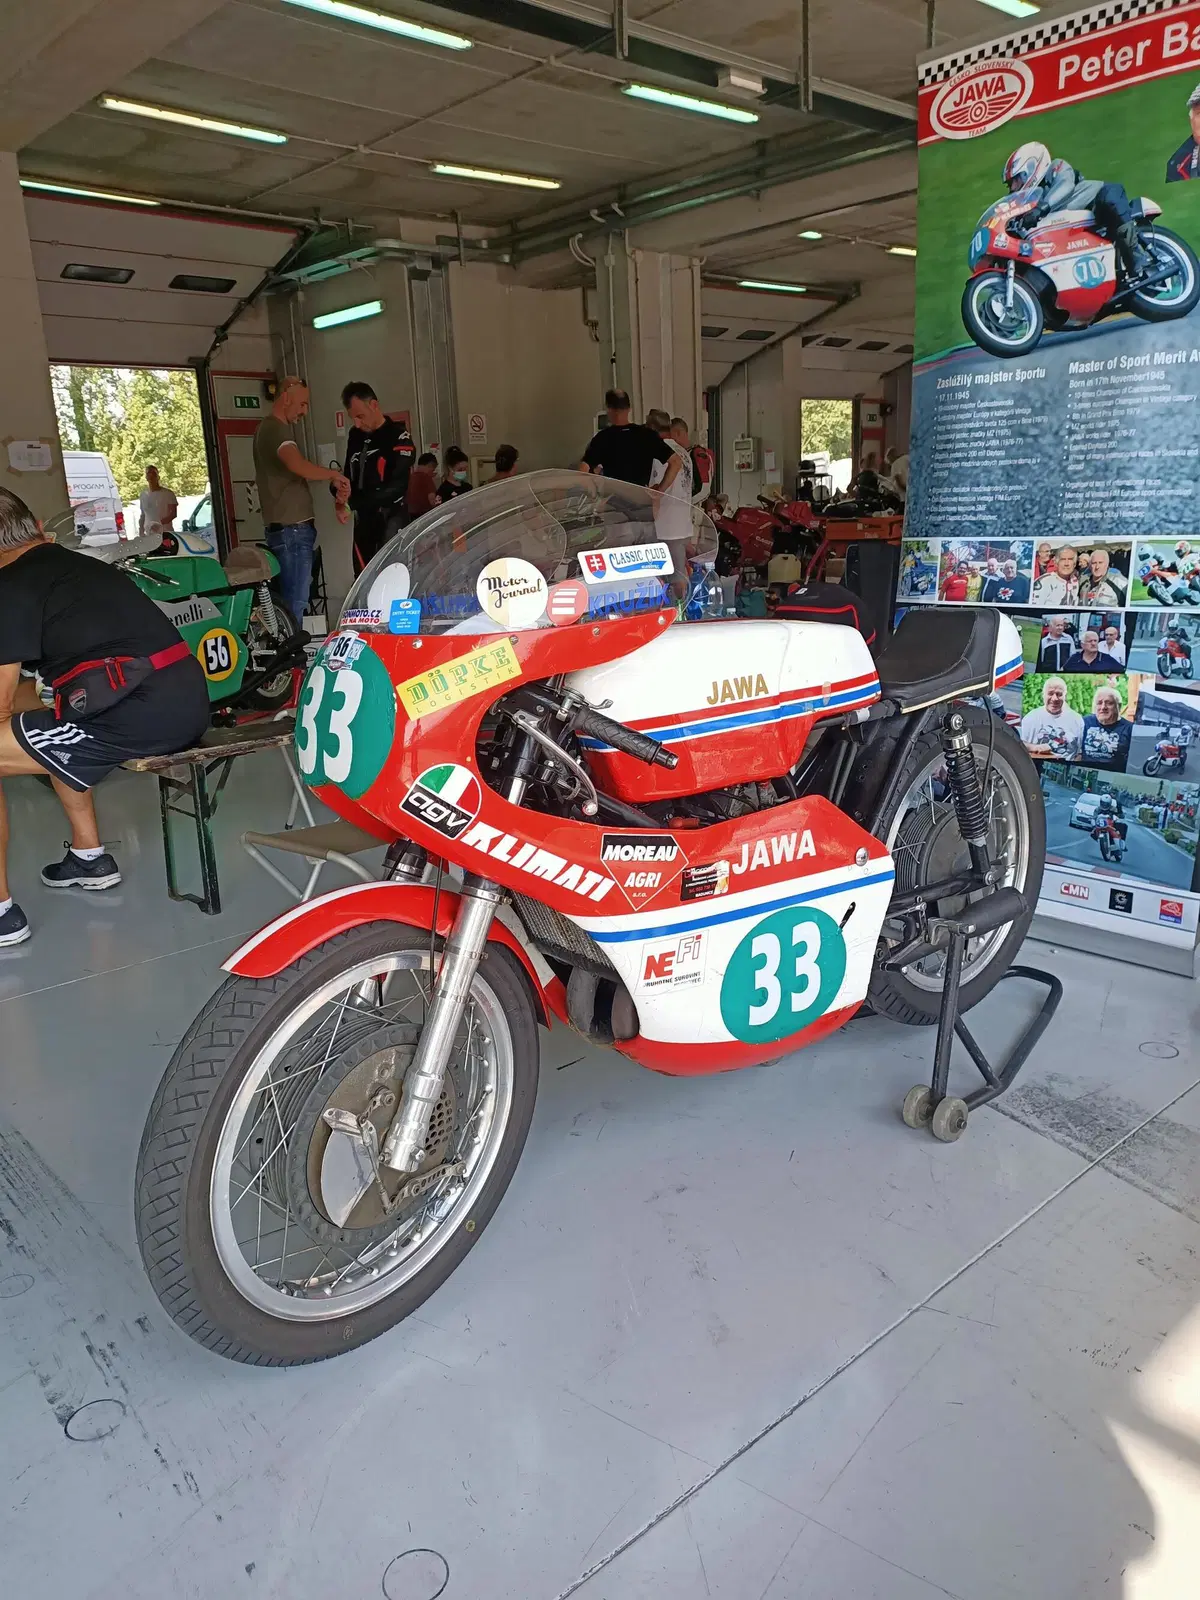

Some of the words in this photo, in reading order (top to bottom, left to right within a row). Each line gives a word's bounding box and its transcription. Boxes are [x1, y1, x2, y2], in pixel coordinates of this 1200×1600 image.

[1058, 38, 1152, 91] Peter
[953, 75, 1006, 107] JAWA
[968, 127, 987, 137] TEAM
[1066, 239, 1089, 250] JAWA
[1077, 259, 1100, 281] 70
[974, 371, 1012, 386] majster
[1015, 367, 1046, 383] športu
[1069, 361, 1105, 374] Master
[1107, 357, 1118, 370] of
[1120, 354, 1150, 370] Sport
[1153, 351, 1186, 365] Merit
[1069, 379, 1085, 388] Born
[609, 549, 644, 567] CLASSIC
[644, 547, 667, 563] CLUB
[481, 576, 529, 591] Motor
[491, 578, 543, 609] Journal
[588, 580, 671, 618] KRUŽÍK
[206, 635, 229, 671] 56
[333, 636, 352, 657] 86
[406, 645, 511, 705] DÖPKE
[416, 667, 515, 714] LOGISTIK
[706, 673, 769, 705] JAWA
[298, 665, 364, 783] 33
[408, 791, 468, 828] agv
[460, 821, 616, 902] KLIMATI
[602, 845, 678, 862] MOREAU
[732, 829, 817, 875] JAWA
[624, 872, 662, 888] AGRI
[1061, 883, 1089, 898] CMN
[748, 920, 822, 1026] 33
